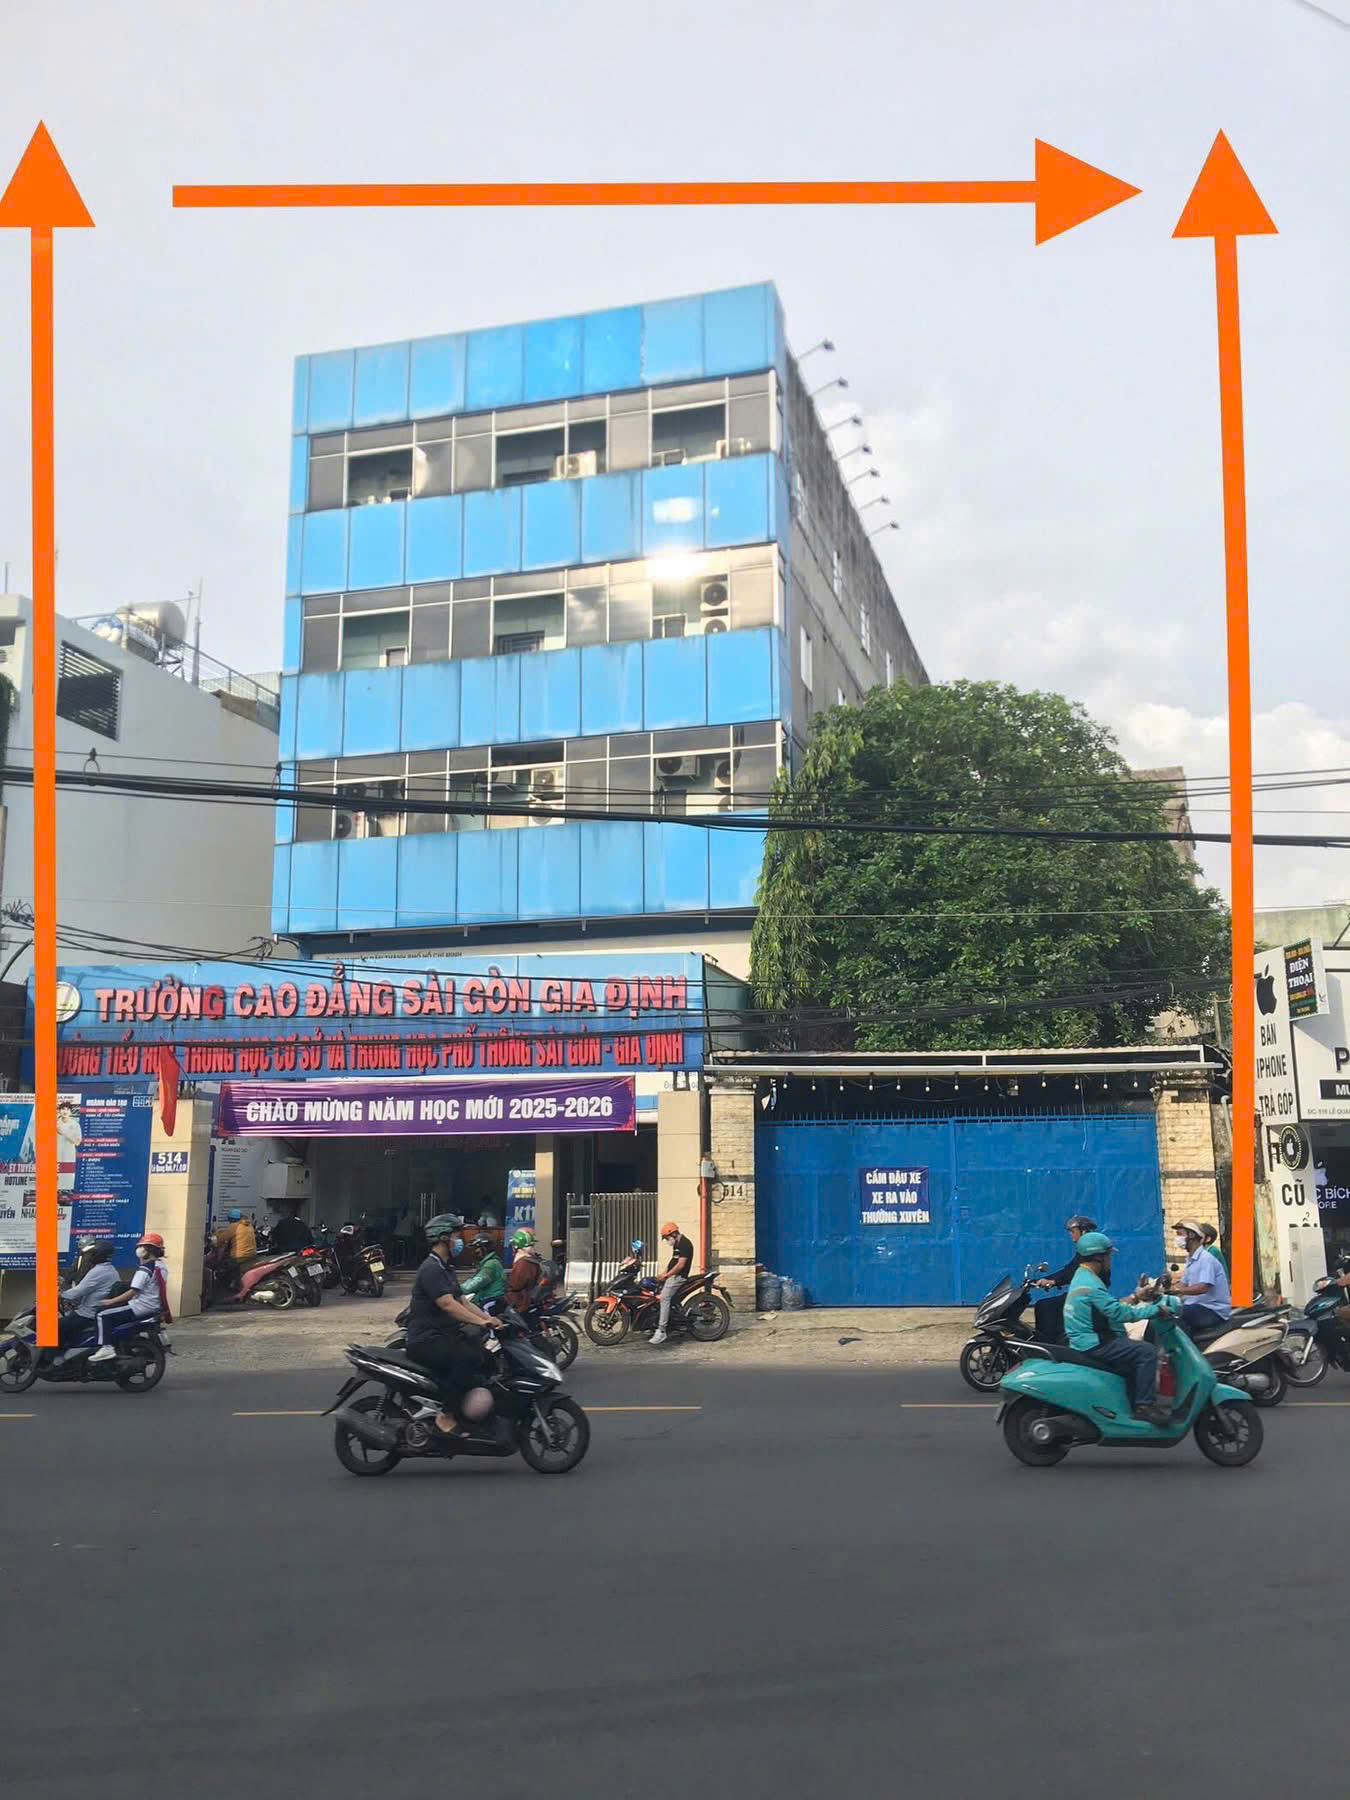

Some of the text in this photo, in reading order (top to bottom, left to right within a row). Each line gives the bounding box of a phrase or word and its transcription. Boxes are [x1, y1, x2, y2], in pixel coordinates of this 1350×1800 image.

[1289, 957, 1309, 974] ĐIỆN
[1288, 972, 1314, 989] THOẠI
[95, 974, 225, 1023] TRƯỜNG
[233, 982, 299, 1018] CAO
[402, 969, 456, 1016] SÀI
[463, 966, 532, 1015] GÒN
[540, 977, 597, 1013] GIA
[604, 975, 688, 1019] ĐỊNH
[1260, 1020, 1277, 1047] BÁN
[350, 1033, 401, 1071] TRUNG
[1256, 1054, 1288, 1079] IPHONE
[247, 1095, 613, 1125] CHÀO MỪNG NĂM HỌC MỚI 2025-2026
[1258, 1087, 1294, 1118] TRẢ GÓP
[158, 1152, 182, 1165] 514
[866, 1168, 922, 1187] CẤM ĐẬU XE
[871, 1188, 918, 1204] XE RA VÀO
[1281, 1178, 1305, 1206] CŨ
[1325, 1185, 1350, 1200] BÍCH
[861, 1208, 930, 1224] THƯỜNG XUYÊN
